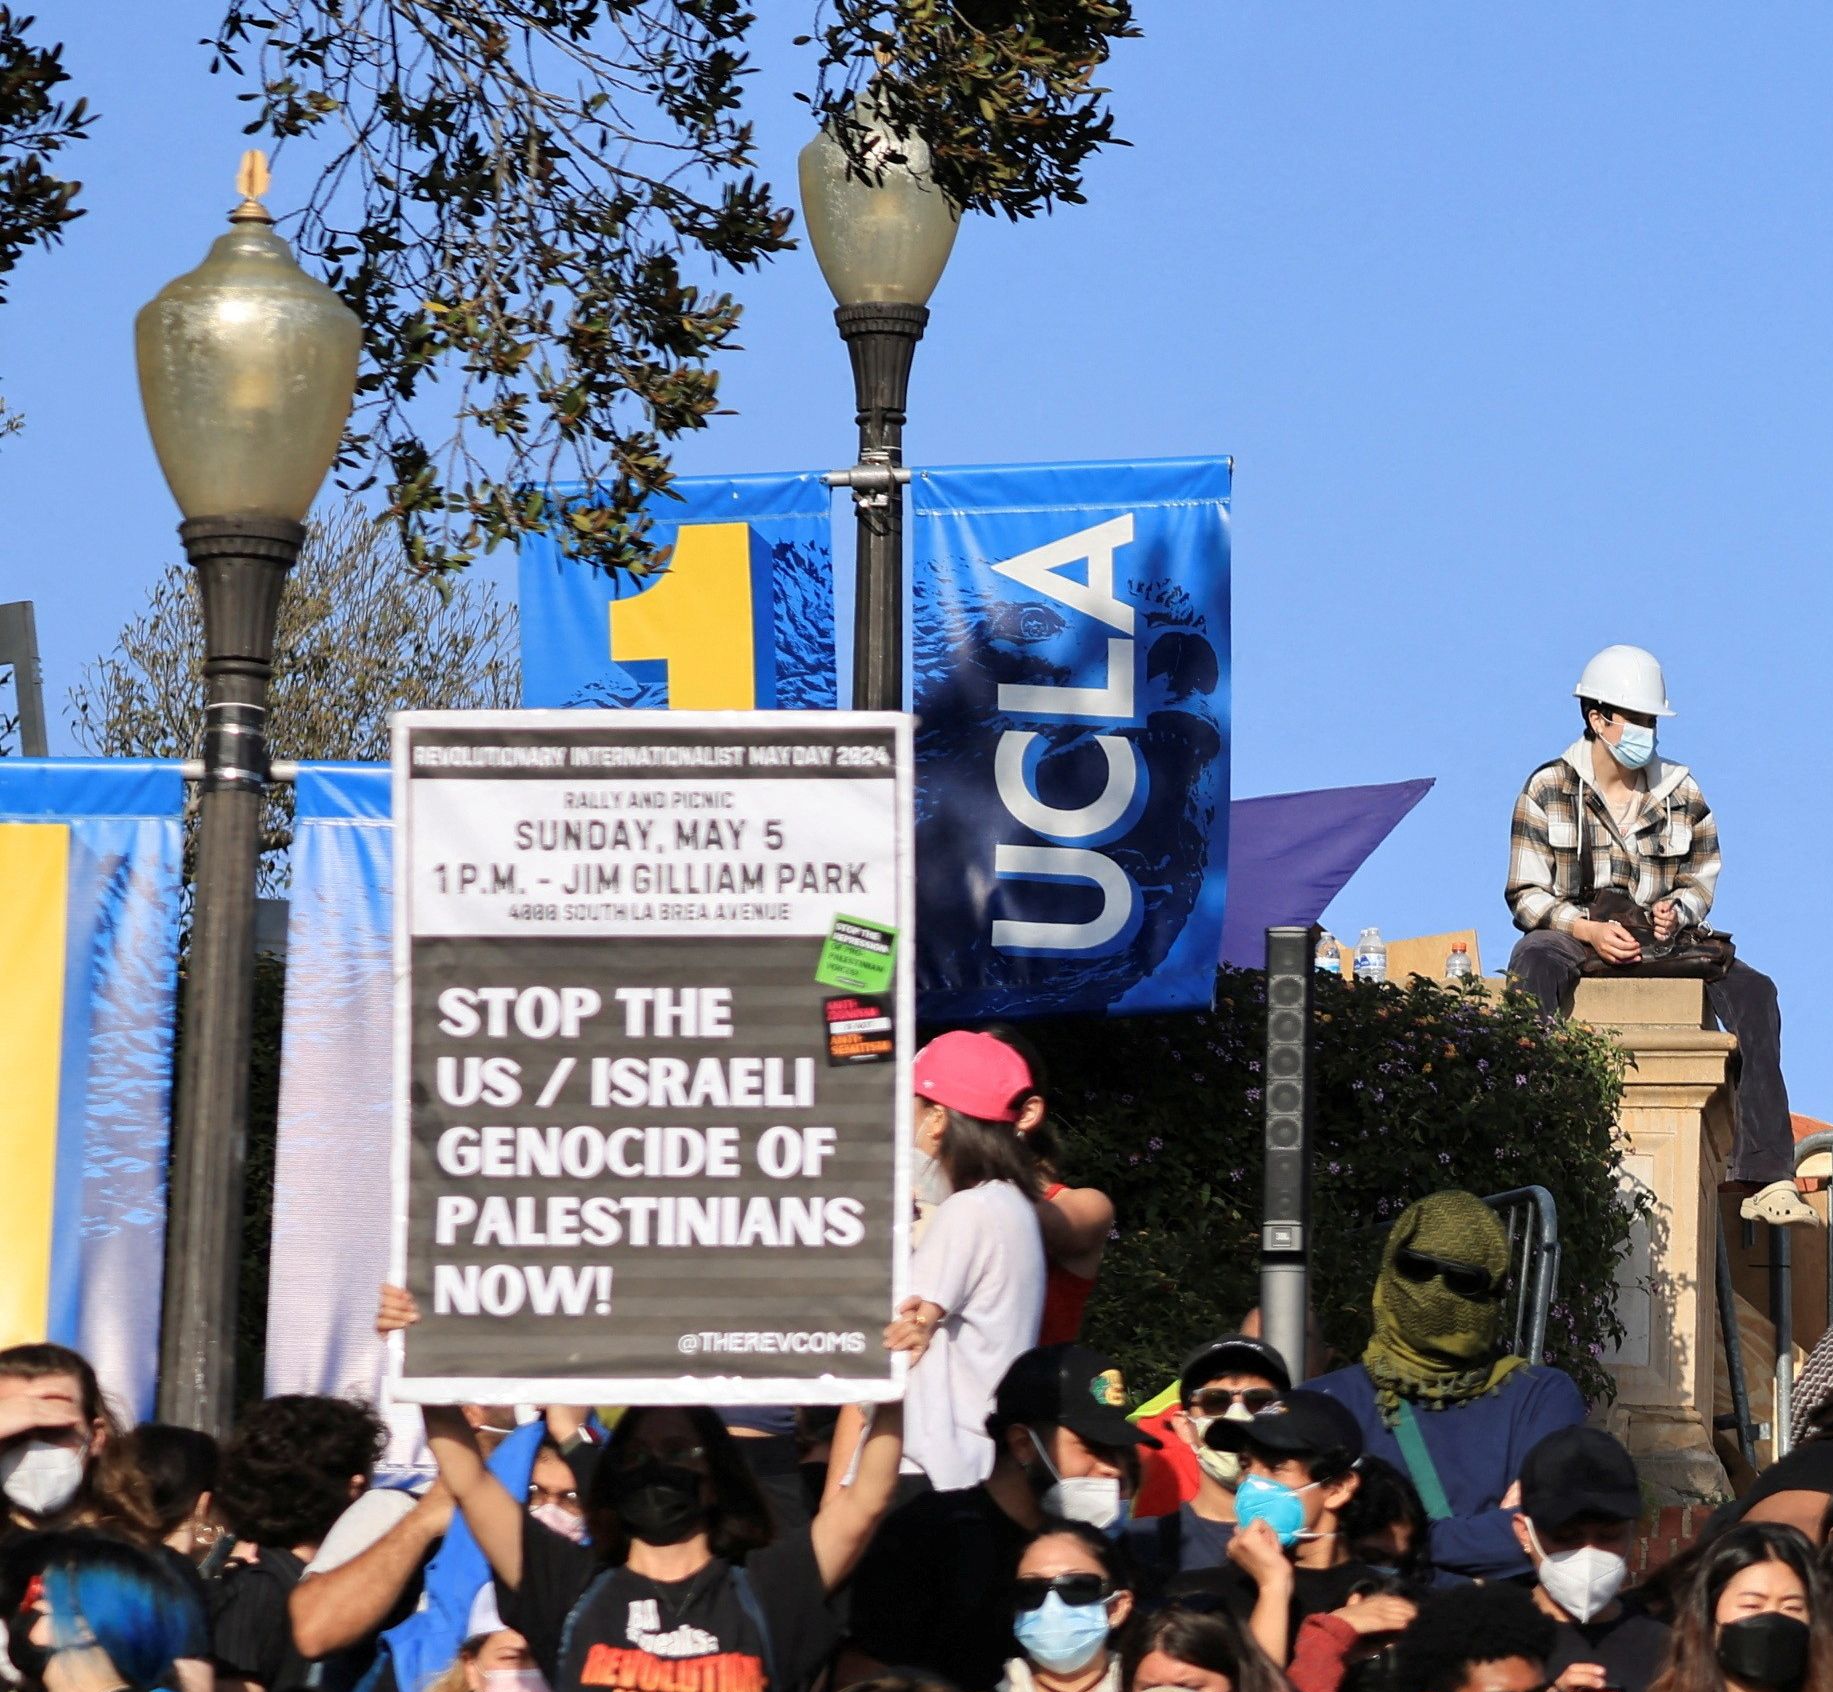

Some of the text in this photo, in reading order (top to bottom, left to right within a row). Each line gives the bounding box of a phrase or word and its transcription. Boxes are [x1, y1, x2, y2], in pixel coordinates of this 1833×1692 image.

[990, 512, 1137, 950] UCLA
[413, 746, 566, 767] REVOLUTIONARY
[570, 746, 745, 767] INTERNATIONALIST
[836, 746, 891, 767] 2024
[563, 791, 735, 808] RALLY AND PICNIC
[515, 818, 784, 854] SUNDAY, MAY 5
[433, 863, 448, 894] 1
[458, 863, 527, 894] P.M.
[562, 863, 621, 894] JIM
[632, 863, 765, 894] GILLIAM
[776, 863, 868, 894] PARK
[563, 903, 629, 920] SOUTH
[631, 903, 654, 920] LA
[658, 903, 709, 920] BREA
[715, 903, 791, 920] AVENUE
[437, 986, 734, 1038] STOP THE
[436, 1057, 815, 1108] US / ISRAELI
[437, 1126, 837, 1179] GENOCIDE OF
[434, 1196, 865, 1249] PALESTINIANS
[434, 1264, 614, 1316] NOW!
[678, 1332, 866, 1354] @THEREVCOMS
